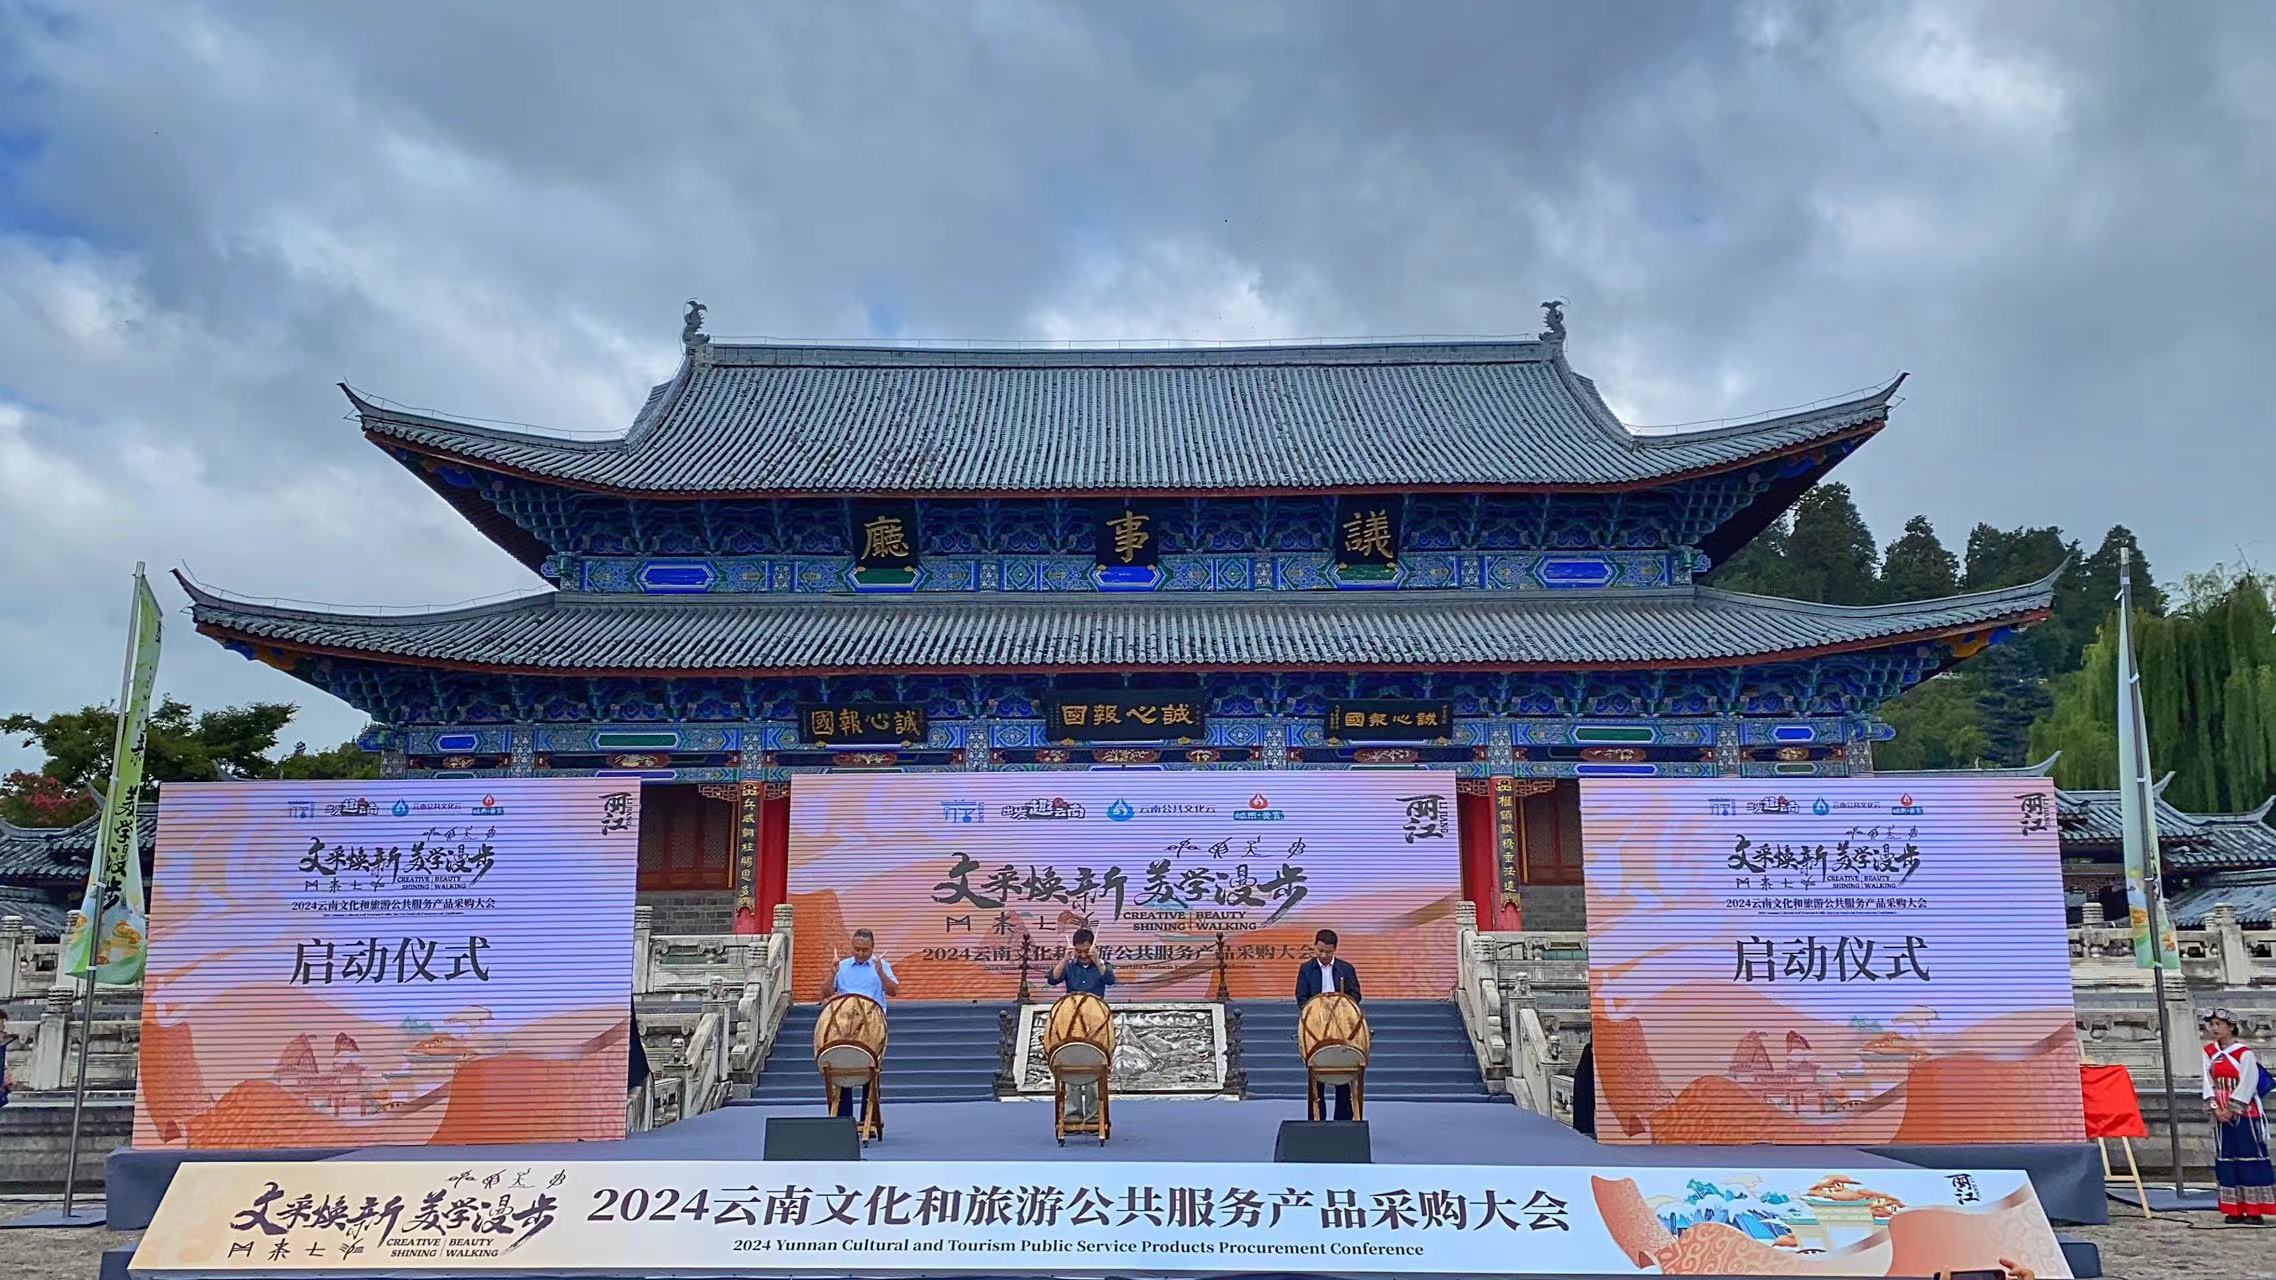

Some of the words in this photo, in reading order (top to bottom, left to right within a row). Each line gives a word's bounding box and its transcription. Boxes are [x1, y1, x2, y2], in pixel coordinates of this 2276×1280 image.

[1105, 510, 1150, 563] 事
[1342, 509, 1394, 559] 議
[1123, 911, 1186, 920] CREATIVE
[1195, 911, 1247, 920] BEAUTY
[1133, 922, 1186, 931] SHINING
[1195, 922, 1257, 931] WALKING
[289, 935, 492, 985] 启动仪式
[1733, 935, 1931, 983] 启动仪式
[586, 1184, 1571, 1232] 2024云南文化和旅游公共服务产品采购大会
[386, 1238, 441, 1246] CREATIVE
[448, 1238, 495, 1246] BEAUTY
[390, 1249, 437, 1257] SHINING
[446, 1249, 499, 1257] WALKING
[733, 1240, 772, 1252] 2024
[776, 1240, 837, 1252] Yunnan
[842, 1239, 909, 1252] Cultural
[913, 1239, 943, 1252] and
[948, 1239, 1016, 1252] Tourism
[1021, 1239, 1073, 1253] Public
[1077, 1240, 1137, 1253] Service
[1141, 1240, 1215, 1253] Products
[1219, 1241, 1327, 1255] Procurement
[1330, 1242, 1424, 1256] Conference
